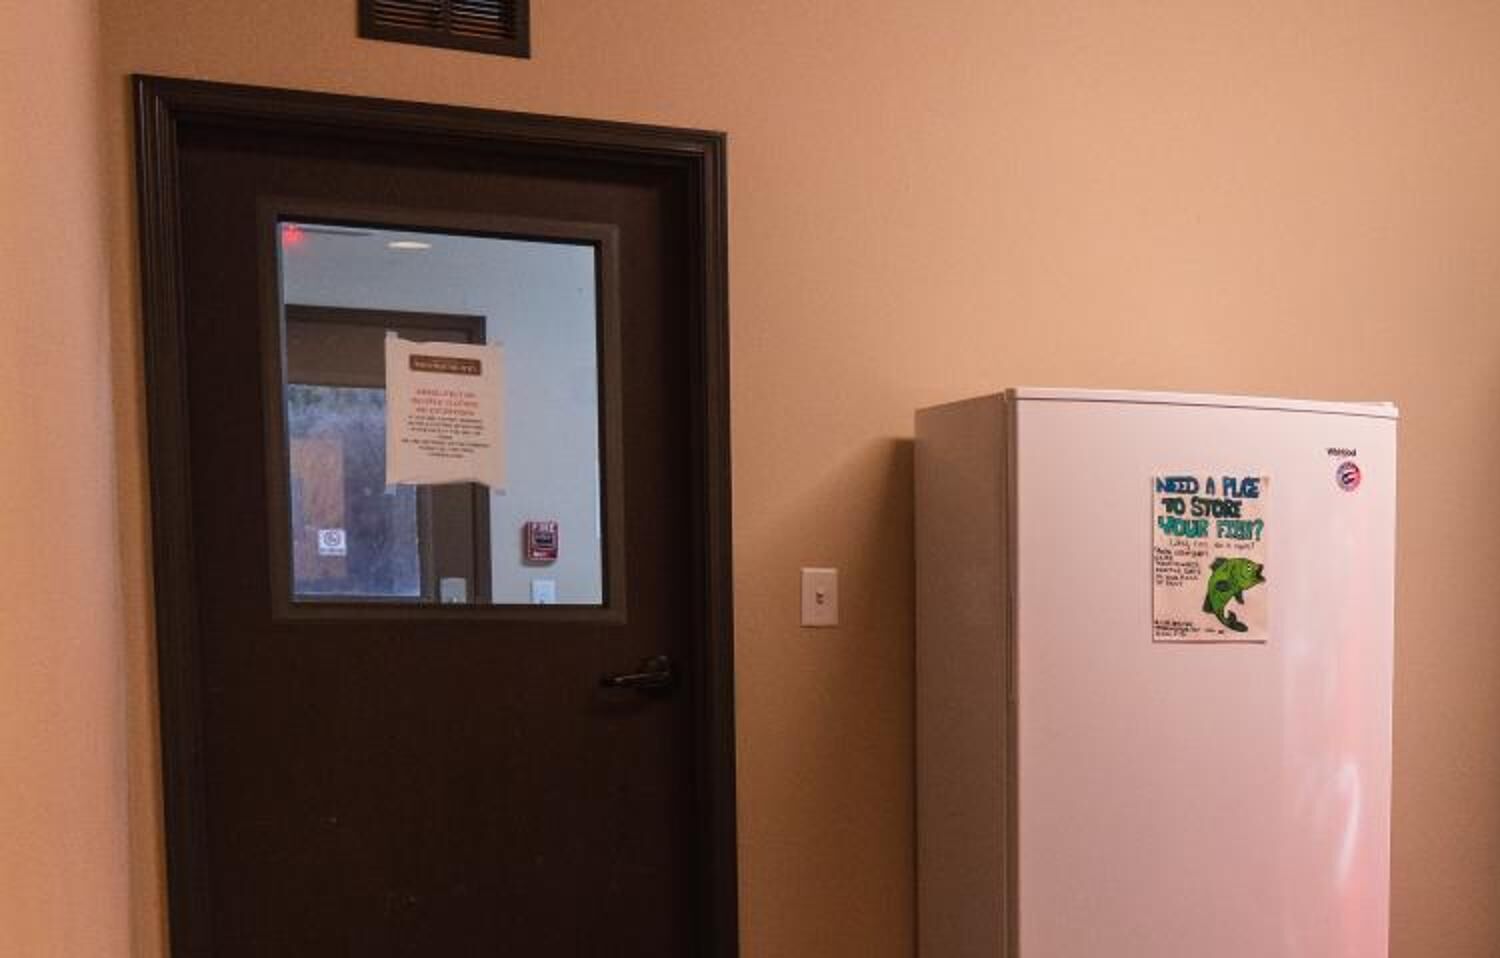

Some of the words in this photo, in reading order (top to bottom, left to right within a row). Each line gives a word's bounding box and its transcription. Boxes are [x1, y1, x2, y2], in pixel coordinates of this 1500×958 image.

[1156, 476, 1199, 495] NEED
[1206, 476, 1216, 496] A
[1161, 497, 1186, 515] TO
[1191, 496, 1243, 518] STORE
[1158, 516, 1209, 538] YOUR
